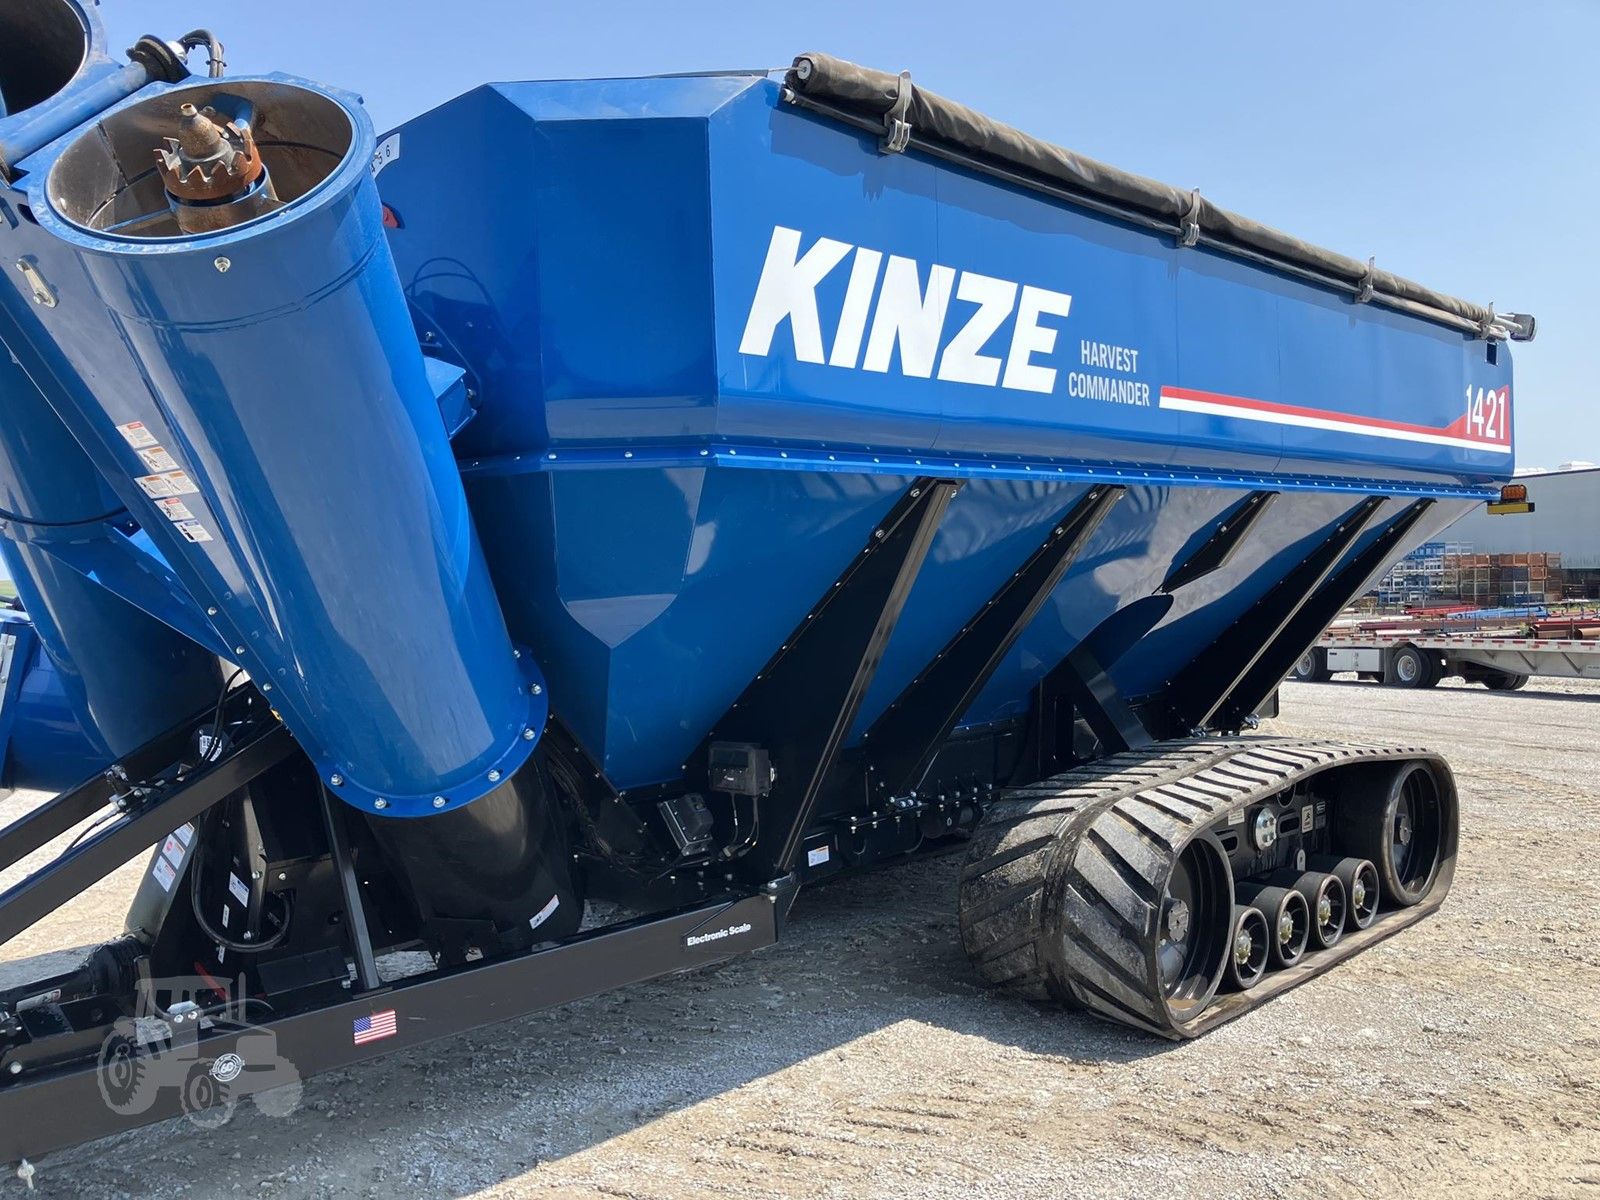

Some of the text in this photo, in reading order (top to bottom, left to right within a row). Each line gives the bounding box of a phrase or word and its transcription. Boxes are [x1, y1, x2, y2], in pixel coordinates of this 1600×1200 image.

[738, 225, 1072, 394] KINZE
[1081, 339, 1138, 374] HARVEST
[1068, 371, 1150, 407] COMMANDER
[1466, 383, 1506, 440] 1421
[687, 922, 752, 947] Electronic Scale
